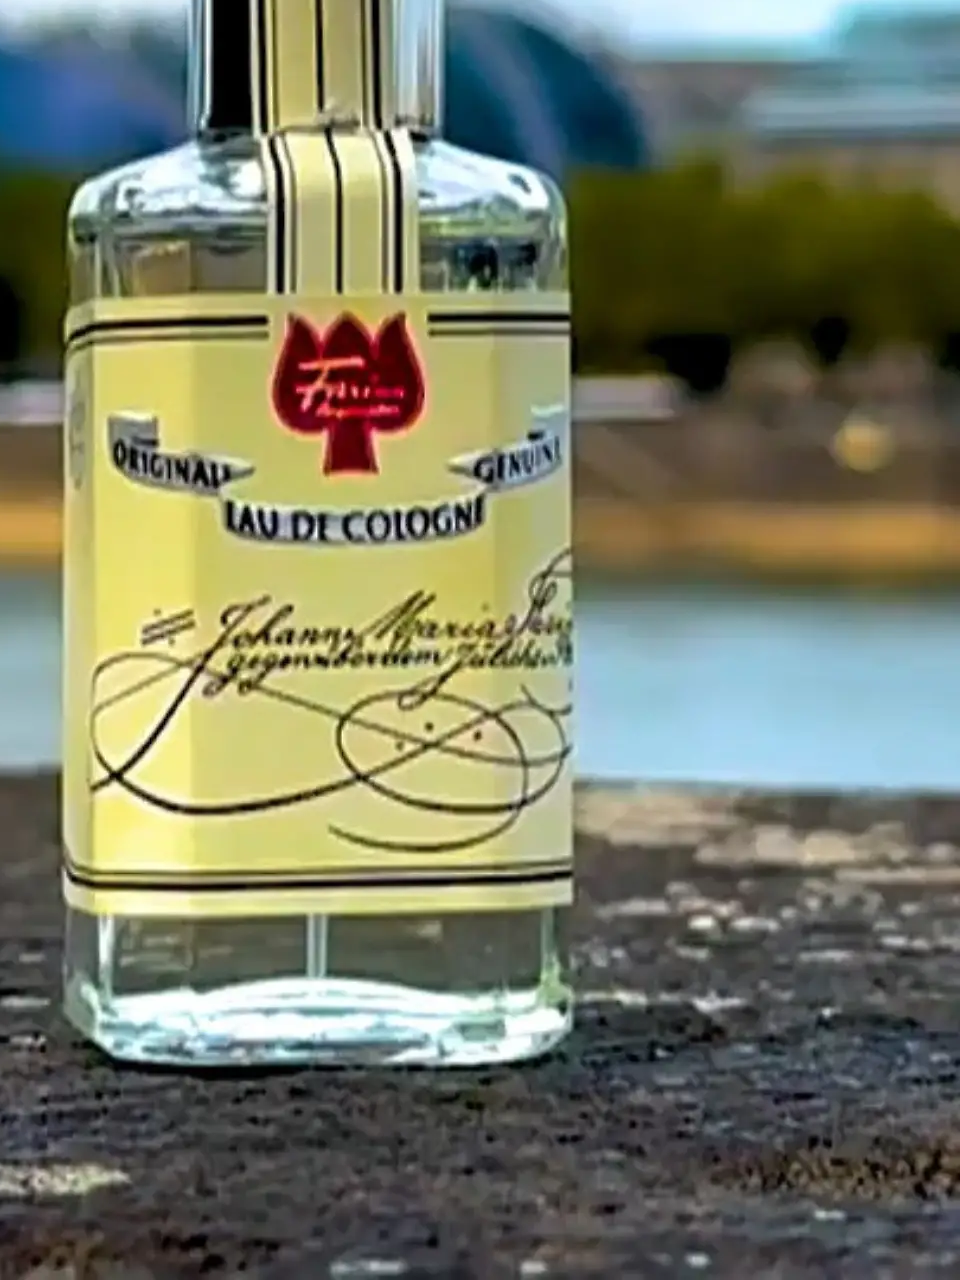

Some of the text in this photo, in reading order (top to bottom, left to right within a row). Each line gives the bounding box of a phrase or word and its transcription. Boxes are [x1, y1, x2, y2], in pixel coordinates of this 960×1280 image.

[113, 438, 232, 489] ORIGINAL
[473, 434, 563, 485] GENUINE
[225, 492, 485, 544] EAU DE COLOGNE
